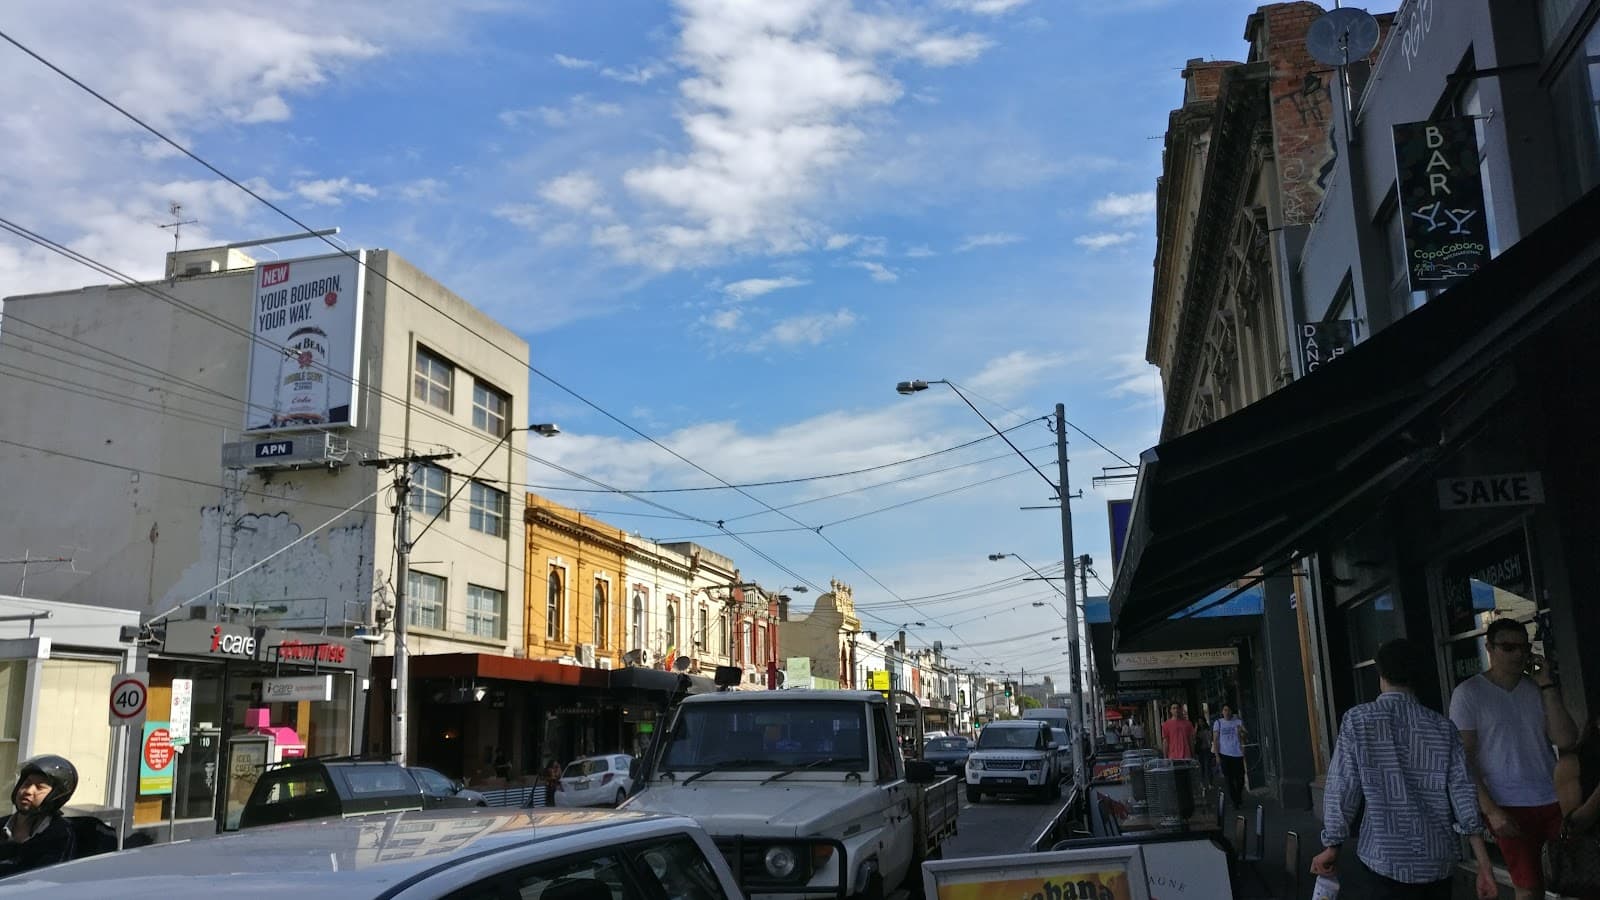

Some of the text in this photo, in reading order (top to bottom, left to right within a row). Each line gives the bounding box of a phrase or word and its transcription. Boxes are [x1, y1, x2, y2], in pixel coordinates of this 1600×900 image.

[1425, 126, 1452, 196] BAR
[263, 268, 287, 284] NEW
[260, 274, 342, 312] YOUR BOURBON.
[259, 302, 312, 332] YOUR WAY.
[260, 443, 287, 456] APN
[1450, 476, 1530, 504] SAKE
[210, 624, 345, 662] i-care optomtrists
[115, 690, 140, 708] 40
